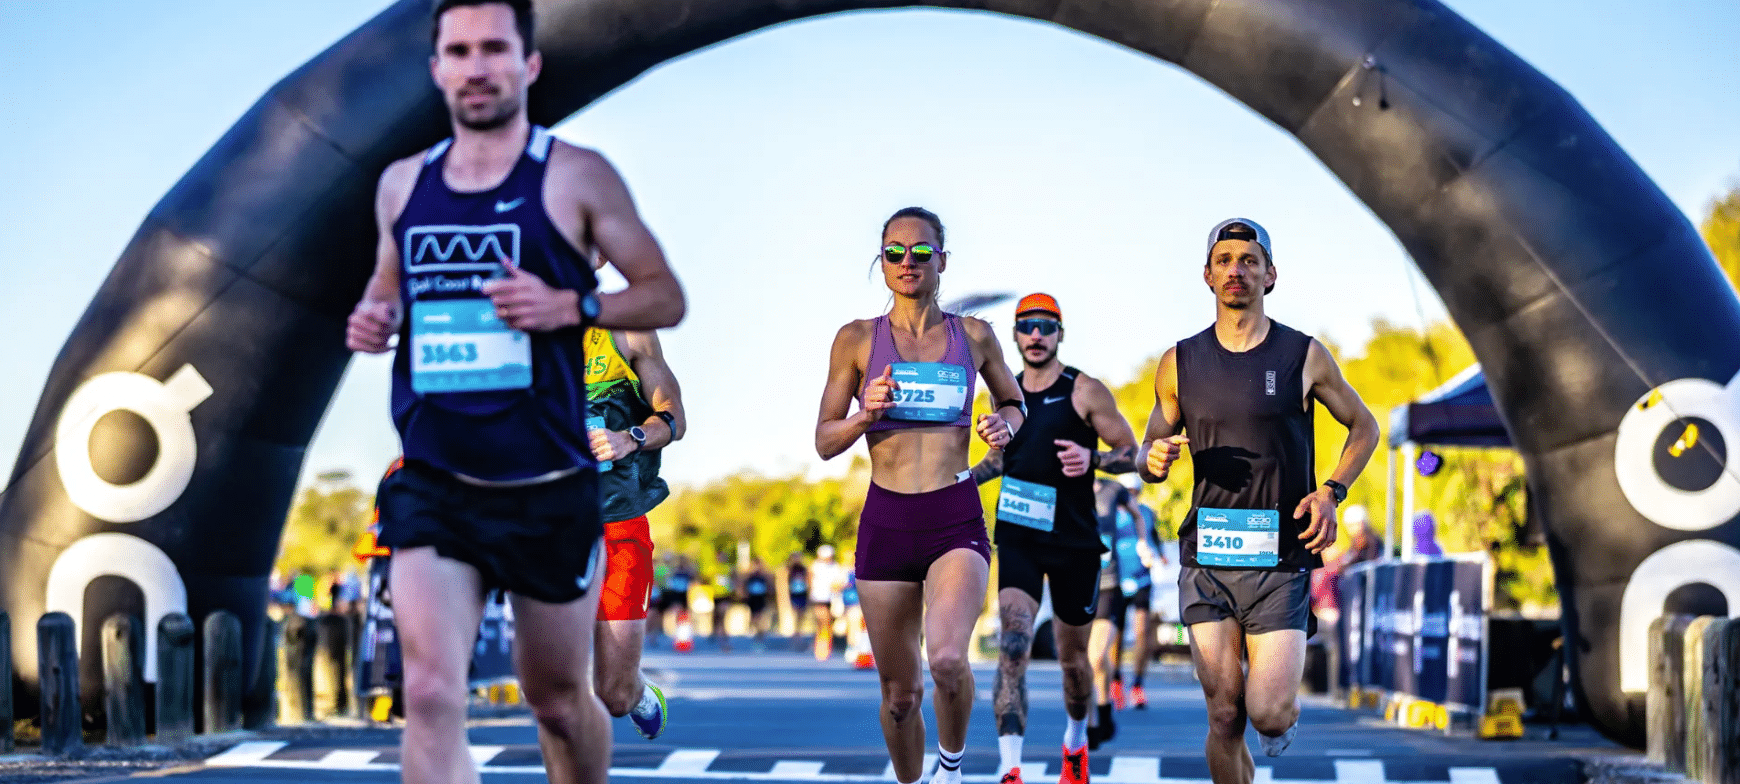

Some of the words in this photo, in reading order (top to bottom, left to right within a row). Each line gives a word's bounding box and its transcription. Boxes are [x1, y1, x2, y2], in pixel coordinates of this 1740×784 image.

[893, 388, 936, 403] 3725
[1003, 498, 1030, 513] 3481
[1203, 535, 1243, 549] 3410
